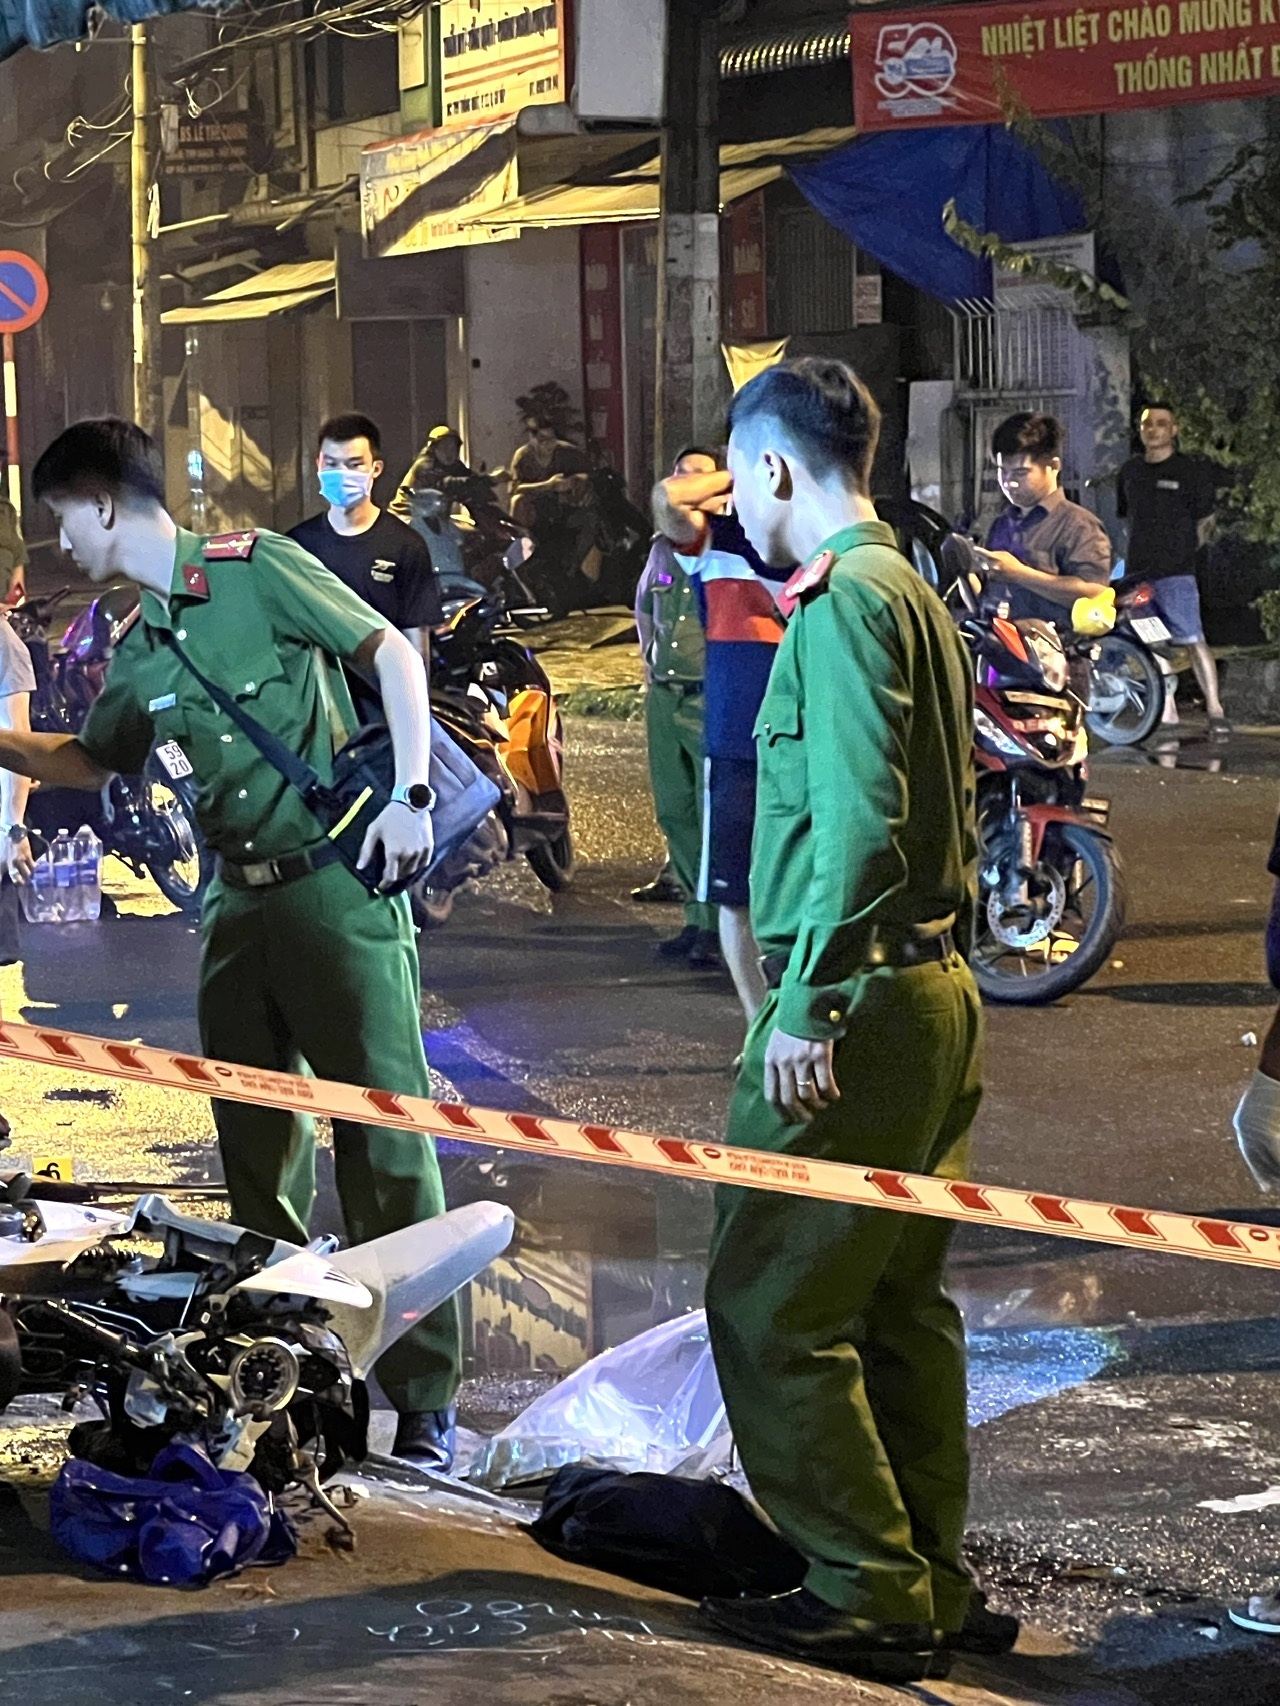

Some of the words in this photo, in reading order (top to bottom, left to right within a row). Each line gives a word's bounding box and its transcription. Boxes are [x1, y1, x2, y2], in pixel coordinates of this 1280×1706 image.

[981, 13, 1047, 59] NHIỆT
[1053, 8, 1100, 53] LIỆT
[1107, 0, 1171, 43] CHÀO
[1114, 47, 1193, 95] THỐNG
[1200, 36, 1264, 85] NHẤT
[164, 745, 182, 759] 59
[170, 760, 189, 775] 20
[47, 1163, 60, 1180] 6
